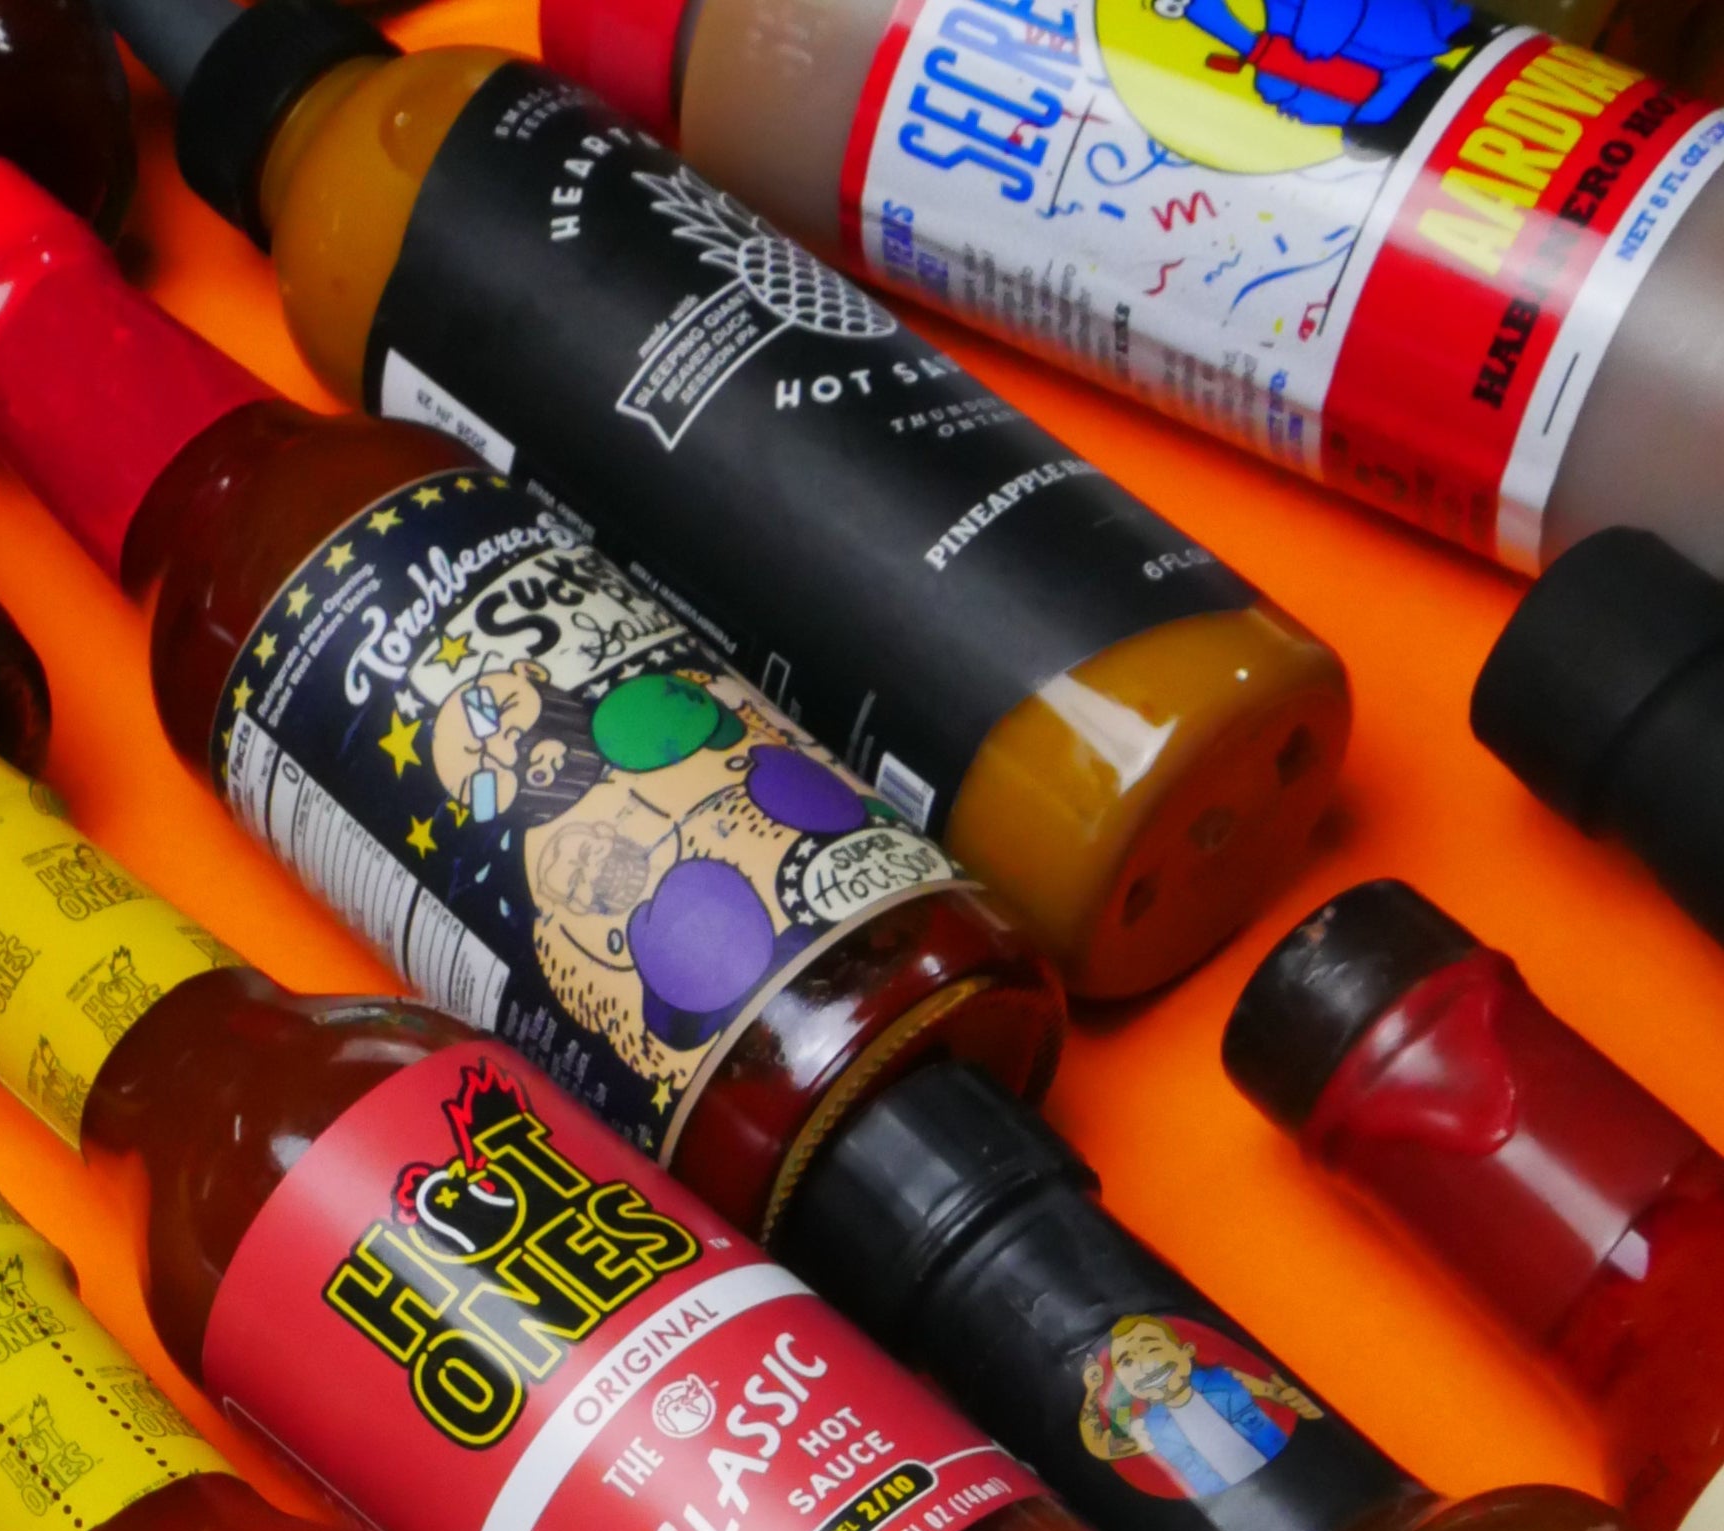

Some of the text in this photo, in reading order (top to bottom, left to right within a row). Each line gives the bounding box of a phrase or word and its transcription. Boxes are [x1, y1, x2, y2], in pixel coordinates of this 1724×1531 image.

[1617, 211, 1658, 262] NET
[775, 369, 873, 411] HOT
[924, 463, 1068, 571] PINEAPPLE
[323, 1111, 590, 1365] HOT
[410, 1180, 704, 1449] ONES
[572, 1298, 720, 1428] ORIGINAL
[602, 1436, 666, 1500] THE
[798, 1406, 862, 1459] HOT
[788, 1430, 895, 1515] SAUCE
[857, 1474, 916, 1521] 2/10
